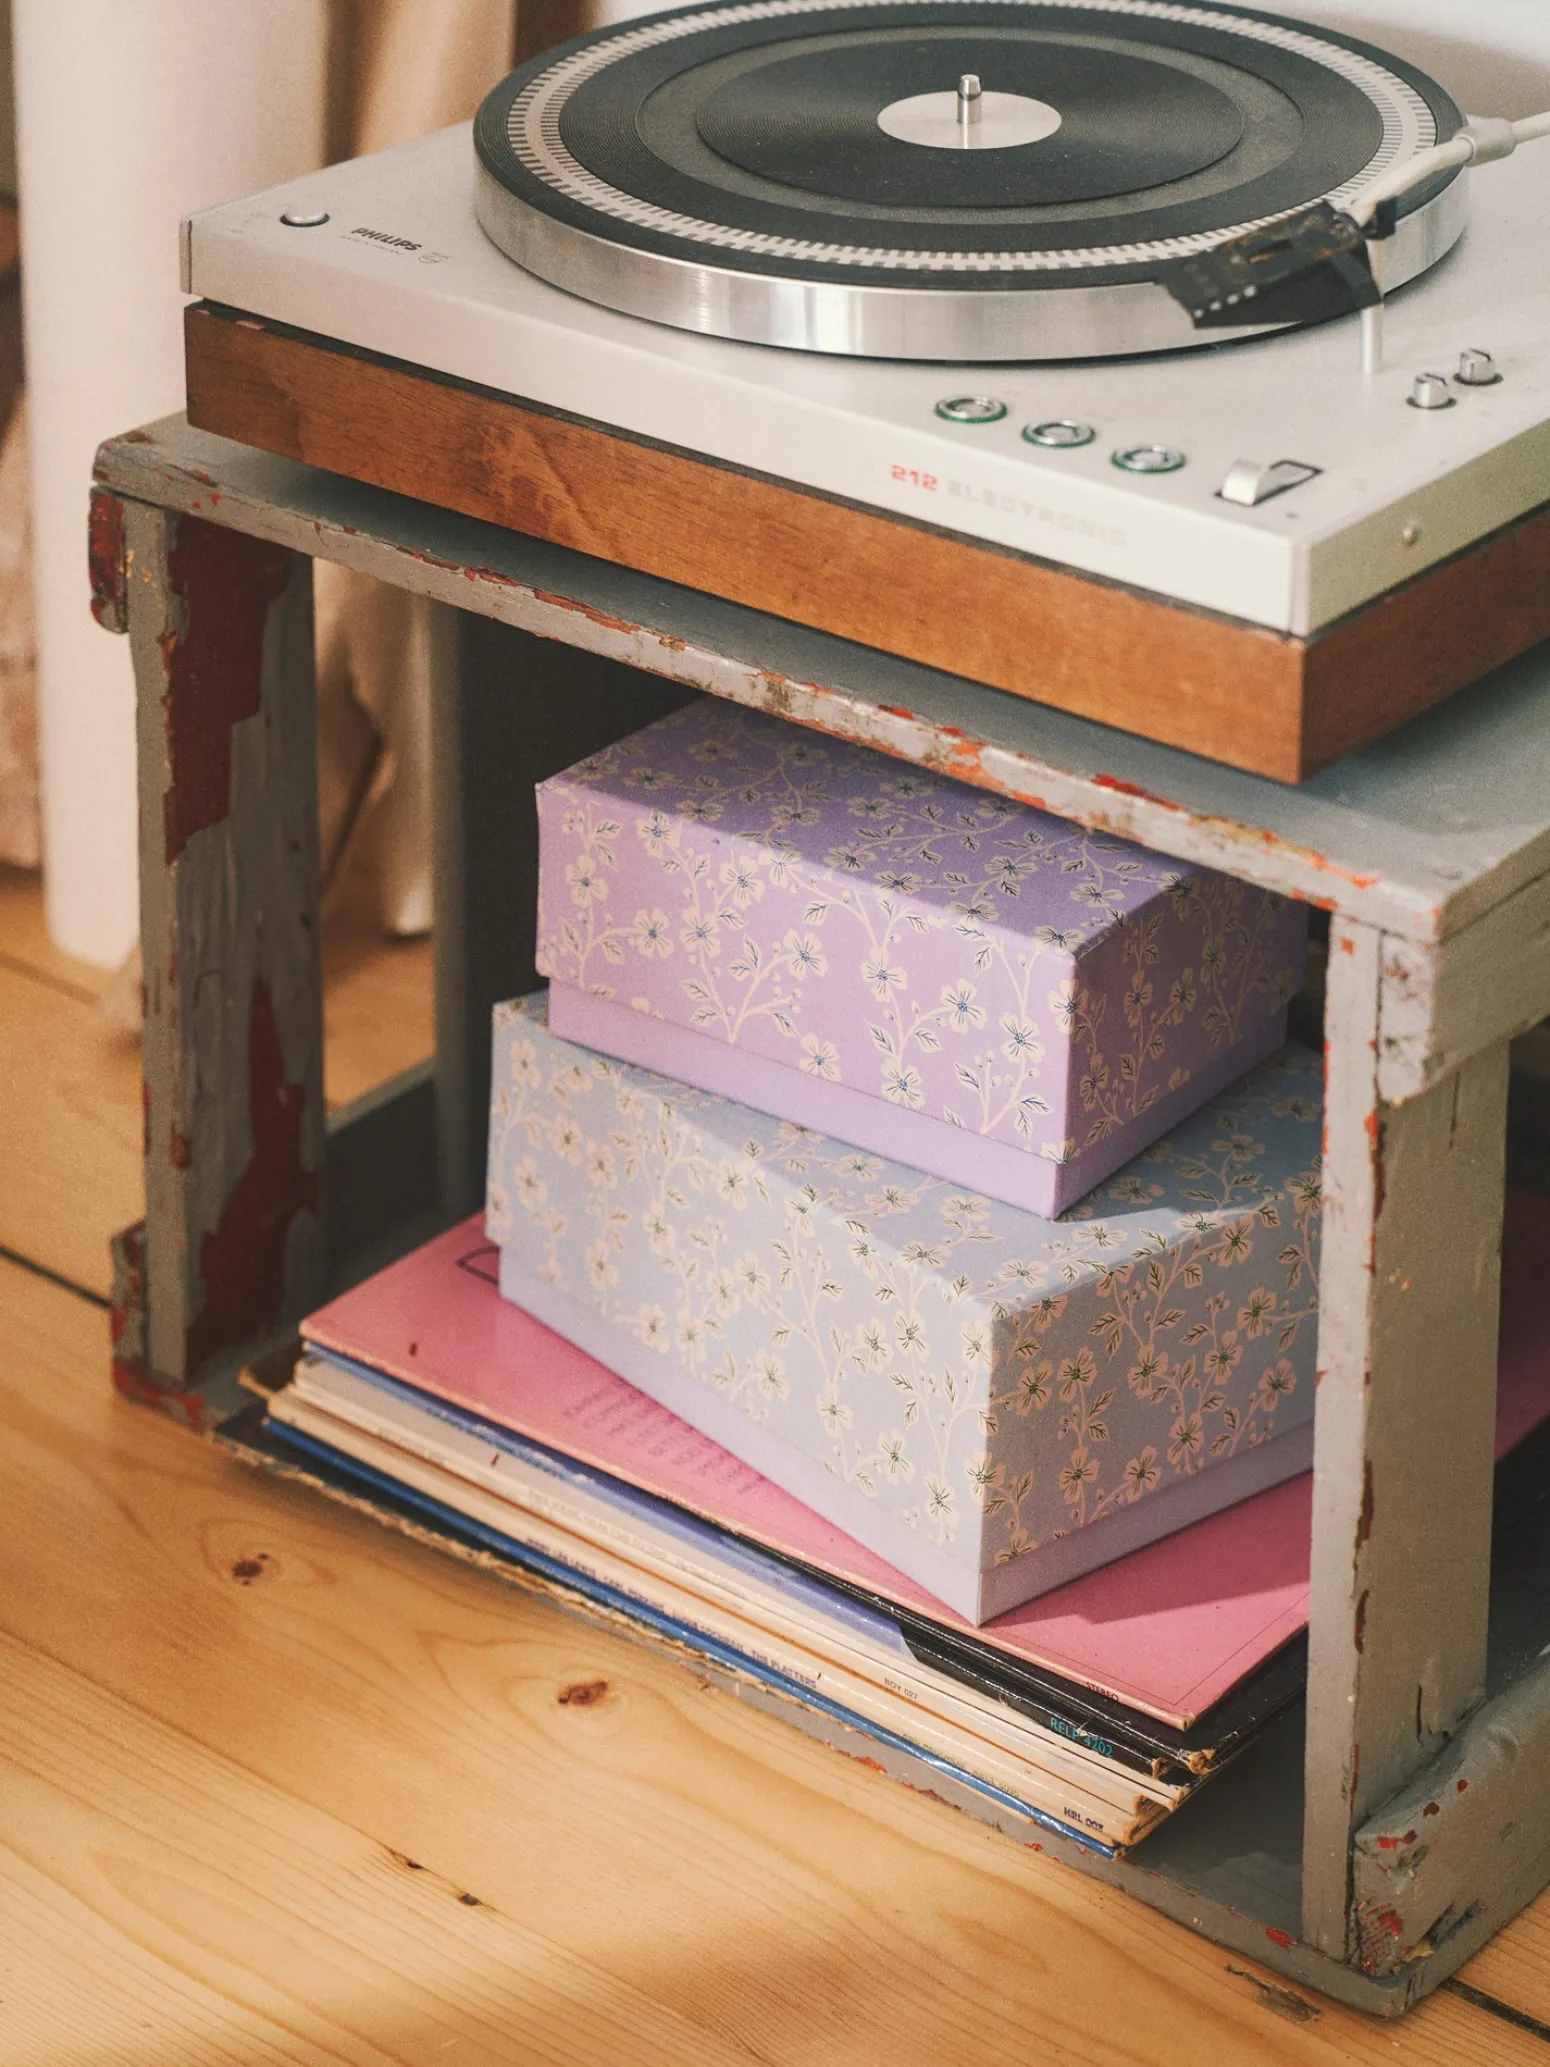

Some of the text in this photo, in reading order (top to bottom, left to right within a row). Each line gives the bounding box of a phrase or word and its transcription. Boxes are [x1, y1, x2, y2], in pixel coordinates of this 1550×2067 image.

[351, 227, 422, 251] PHILIPS
[891, 463, 1131, 545] 212 ELECTRONIC
[751, 1649, 768, 1664] THE
[770, 1659, 818, 1689] PLATTERS
[1050, 1717, 1114, 1758] RELP 4202
